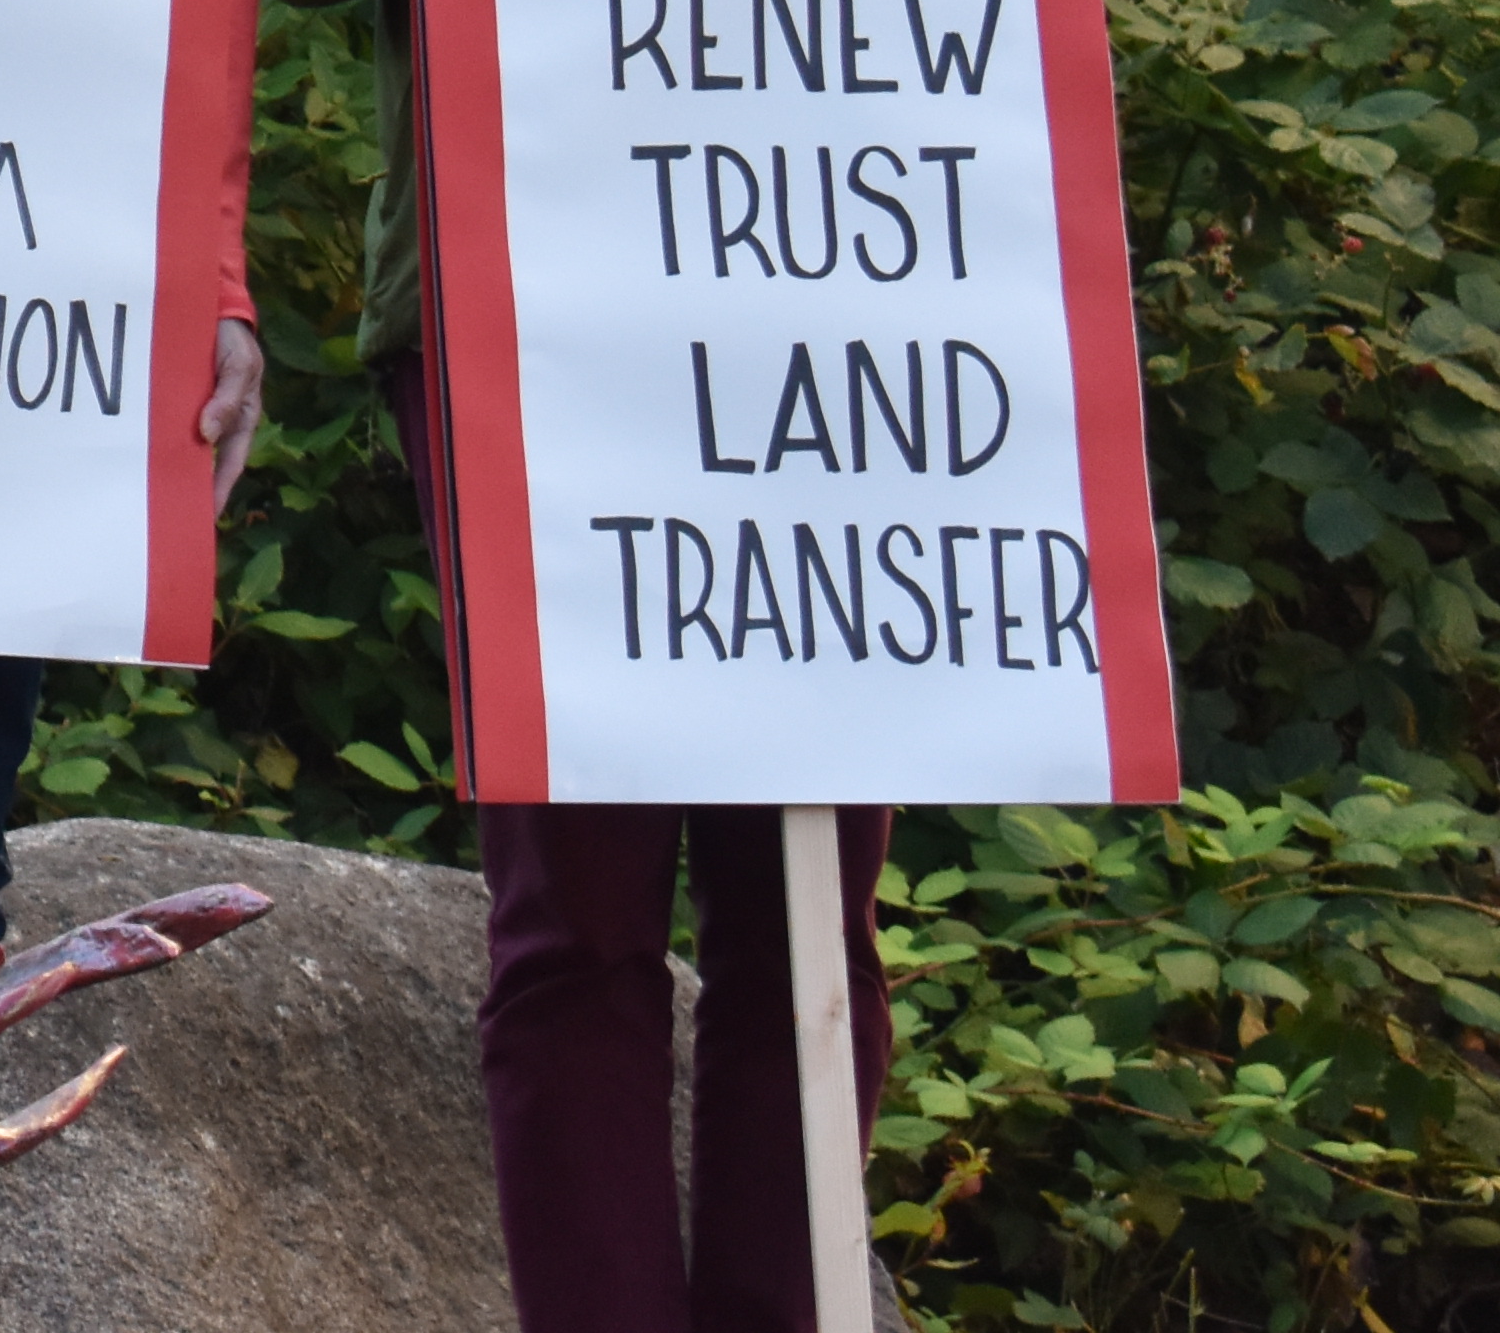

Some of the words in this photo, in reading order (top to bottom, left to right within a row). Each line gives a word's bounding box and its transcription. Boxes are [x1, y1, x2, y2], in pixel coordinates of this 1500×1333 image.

[631, 145, 976, 282] TRUST
[691, 340, 1010, 476] LAND
[590, 515, 1101, 674] TRANSFER
